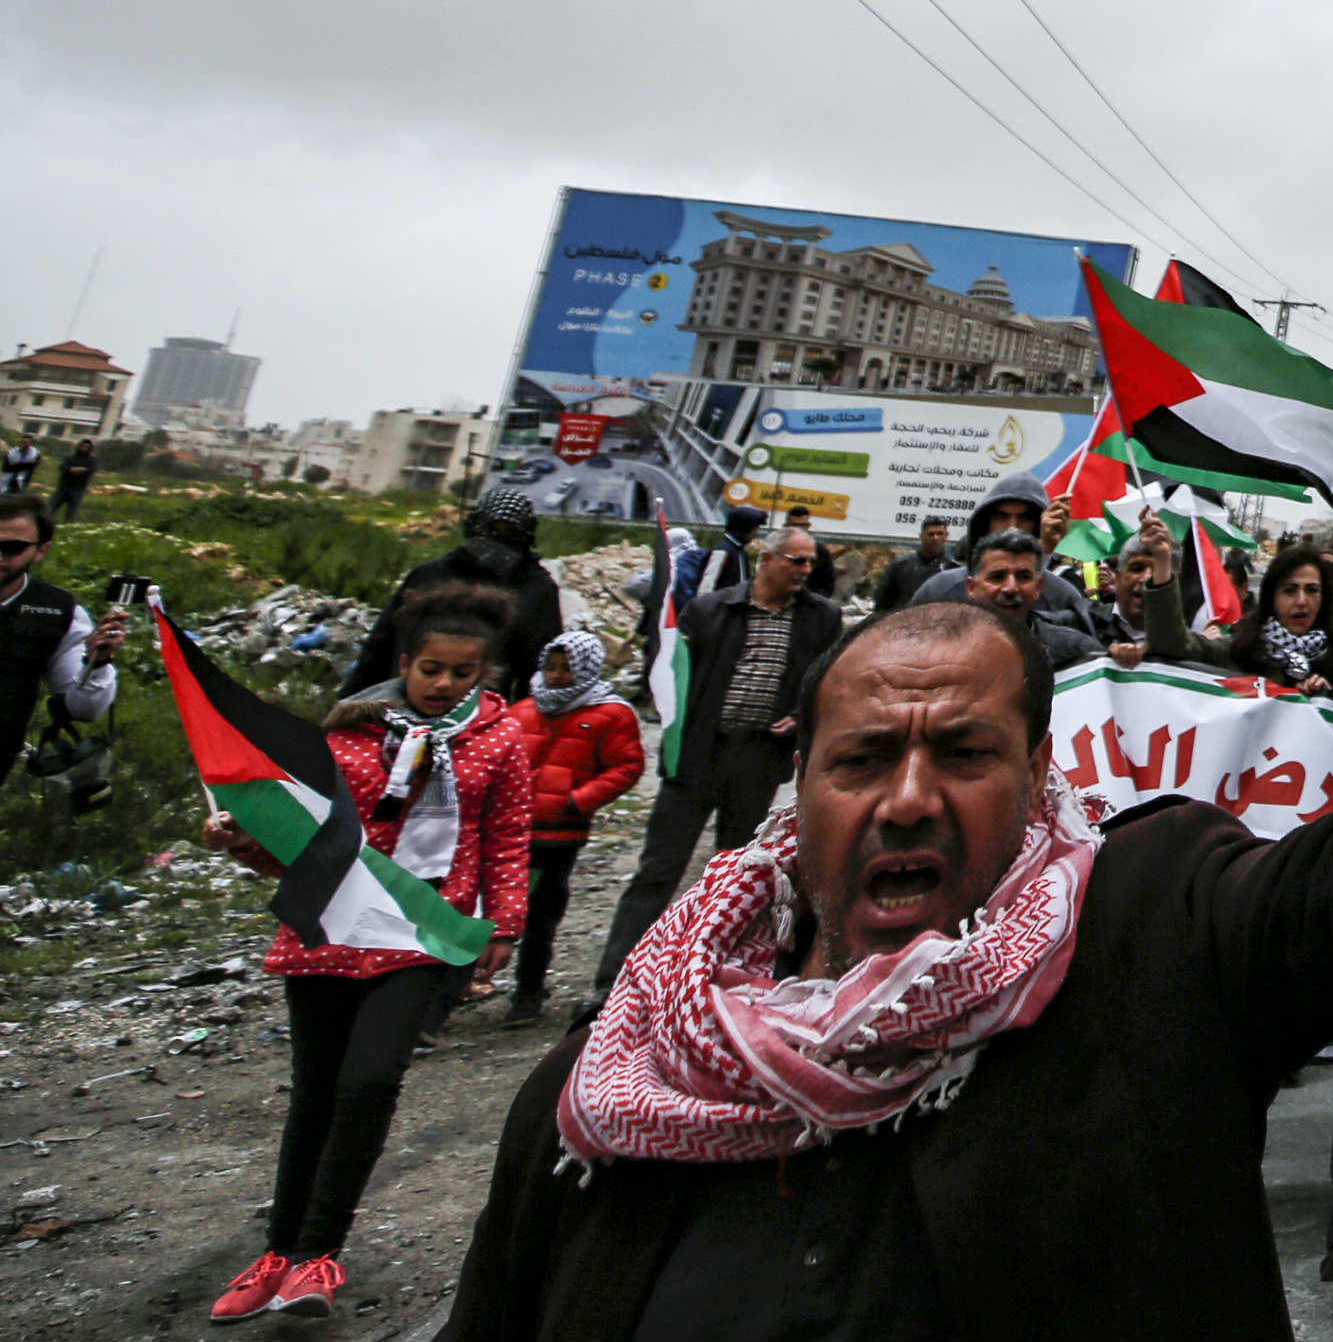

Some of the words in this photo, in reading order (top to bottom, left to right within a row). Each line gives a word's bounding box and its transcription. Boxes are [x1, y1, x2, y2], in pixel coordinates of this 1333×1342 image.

[573, 269, 642, 288] PHASE
[958, 427, 989, 438] شركة
[888, 461, 920, 474] تجارية
[922, 464, 963, 477] ومحلات
[967, 467, 999, 479] مكاتب
[899, 496, 920, 508] 059
[20, 604, 63, 616] Press
